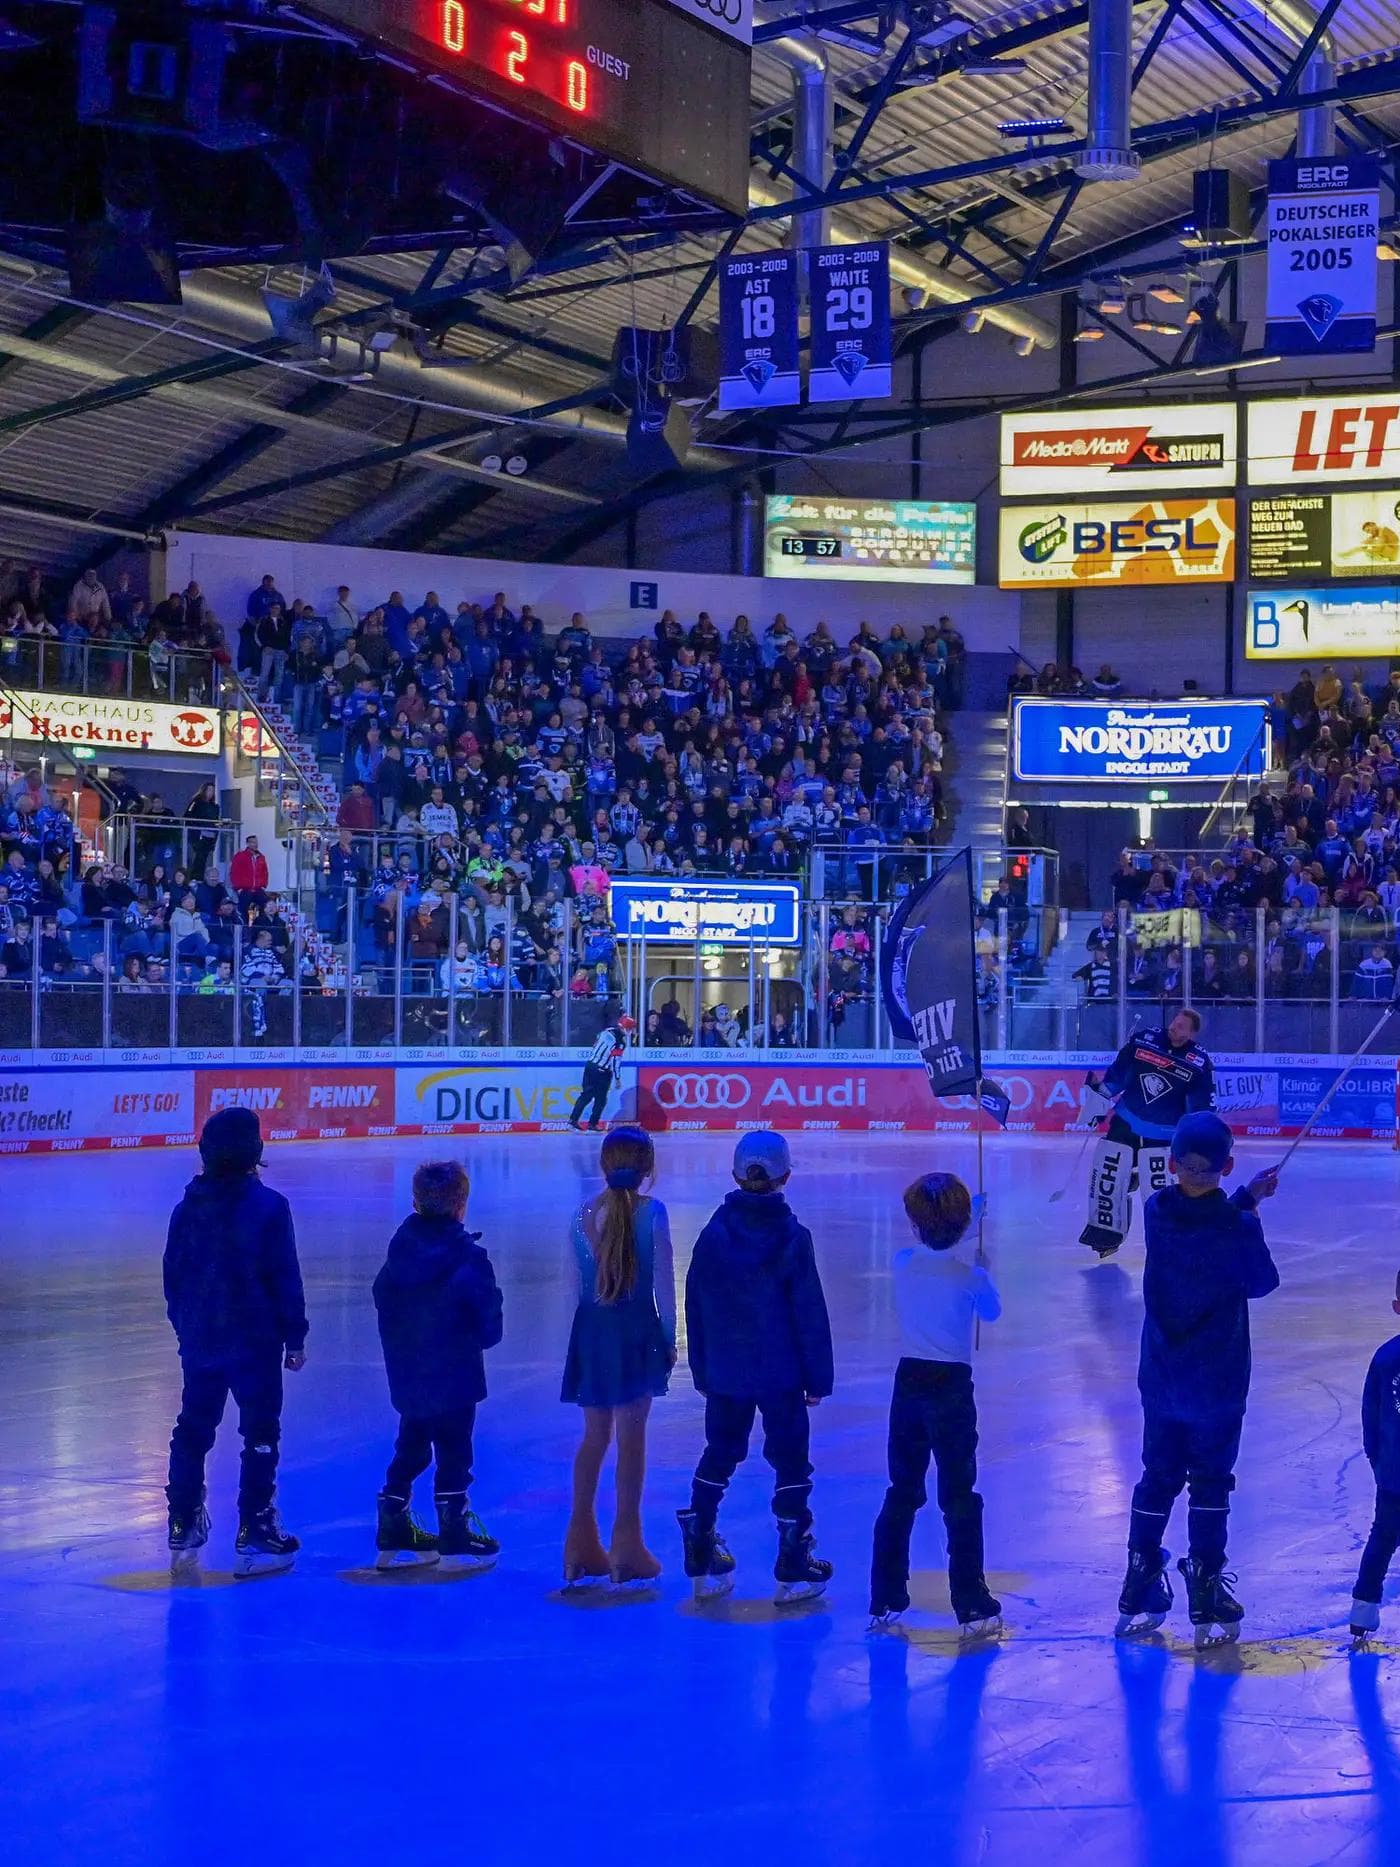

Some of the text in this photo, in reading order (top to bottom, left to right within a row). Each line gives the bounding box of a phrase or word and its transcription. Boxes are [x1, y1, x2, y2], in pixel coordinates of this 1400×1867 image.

[507, 31, 527, 83] 2
[586, 45, 632, 81] GUEST
[1297, 165, 1350, 182] ERC
[1276, 203, 1370, 221] DEUTSCHER
[1269, 223, 1376, 243] POKALSIEGER
[1290, 247, 1353, 272] 2005
[745, 279, 770, 295] AST
[829, 269, 869, 287] WAITE
[740, 296, 775, 339] 18
[826, 287, 873, 331] 29
[1168, 443, 1221, 463] SATURN
[1252, 501, 1270, 511] DER
[1252, 512, 1273, 521] WEG
[1073, 518, 1219, 554] BESL
[785, 541, 837, 554] 13 57
[31, 698, 154, 723] BACKHAUS
[30, 716, 154, 746] Hackner
[1059, 725, 1232, 759] NORDBRÄU
[1105, 761, 1191, 774] INGOLSTADT
[762, 1077, 867, 1107] Audi
[1237, 1075, 1263, 1095] GUY
[113, 1092, 180, 1113] LET'S GO!
[18, 1110, 72, 1131] Check!
